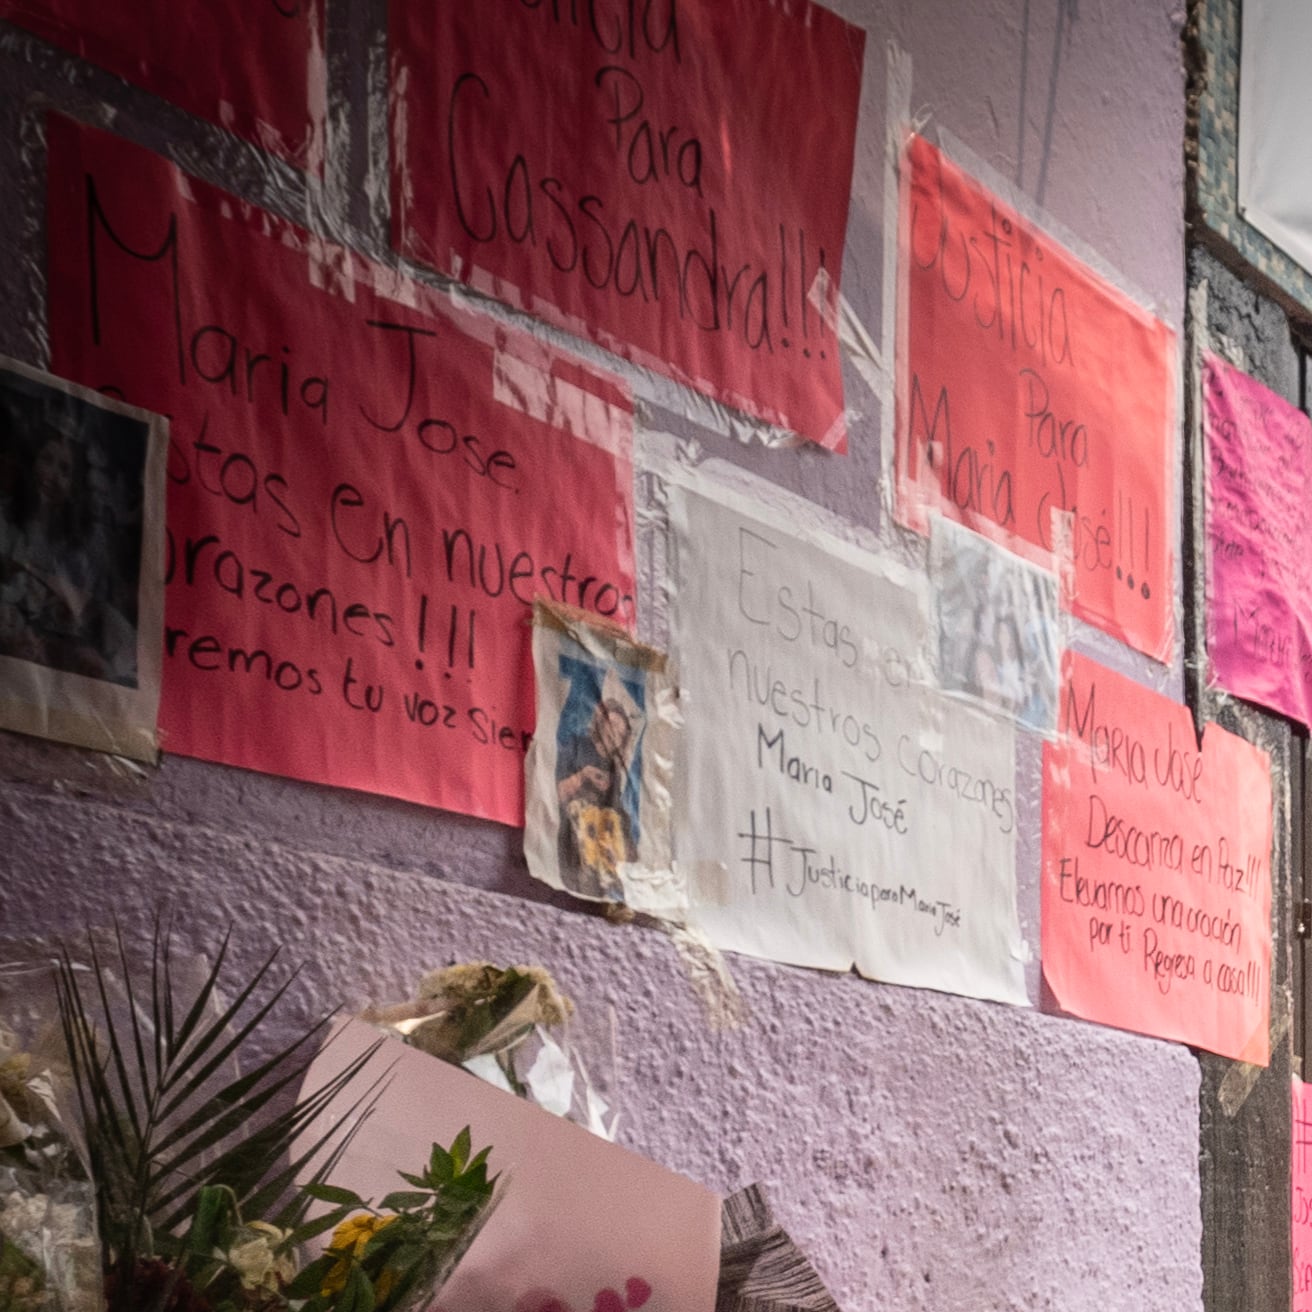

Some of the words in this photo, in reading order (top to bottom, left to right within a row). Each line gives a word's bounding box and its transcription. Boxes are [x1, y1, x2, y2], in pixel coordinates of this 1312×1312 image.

[596, 66, 704, 198] Para
[1019, 368, 1090, 468] Para
[165, 412, 302, 538] stas
[331, 483, 412, 578] en
[1037, 463, 1153, 600] Jsé!!!
[739, 527, 858, 668] Estas
[166, 646, 322, 696] remos
[342, 656, 384, 714] tu
[404, 692, 456, 730] voz
[728, 647, 882, 764] nuestros
[1191, 843, 1213, 884] en
